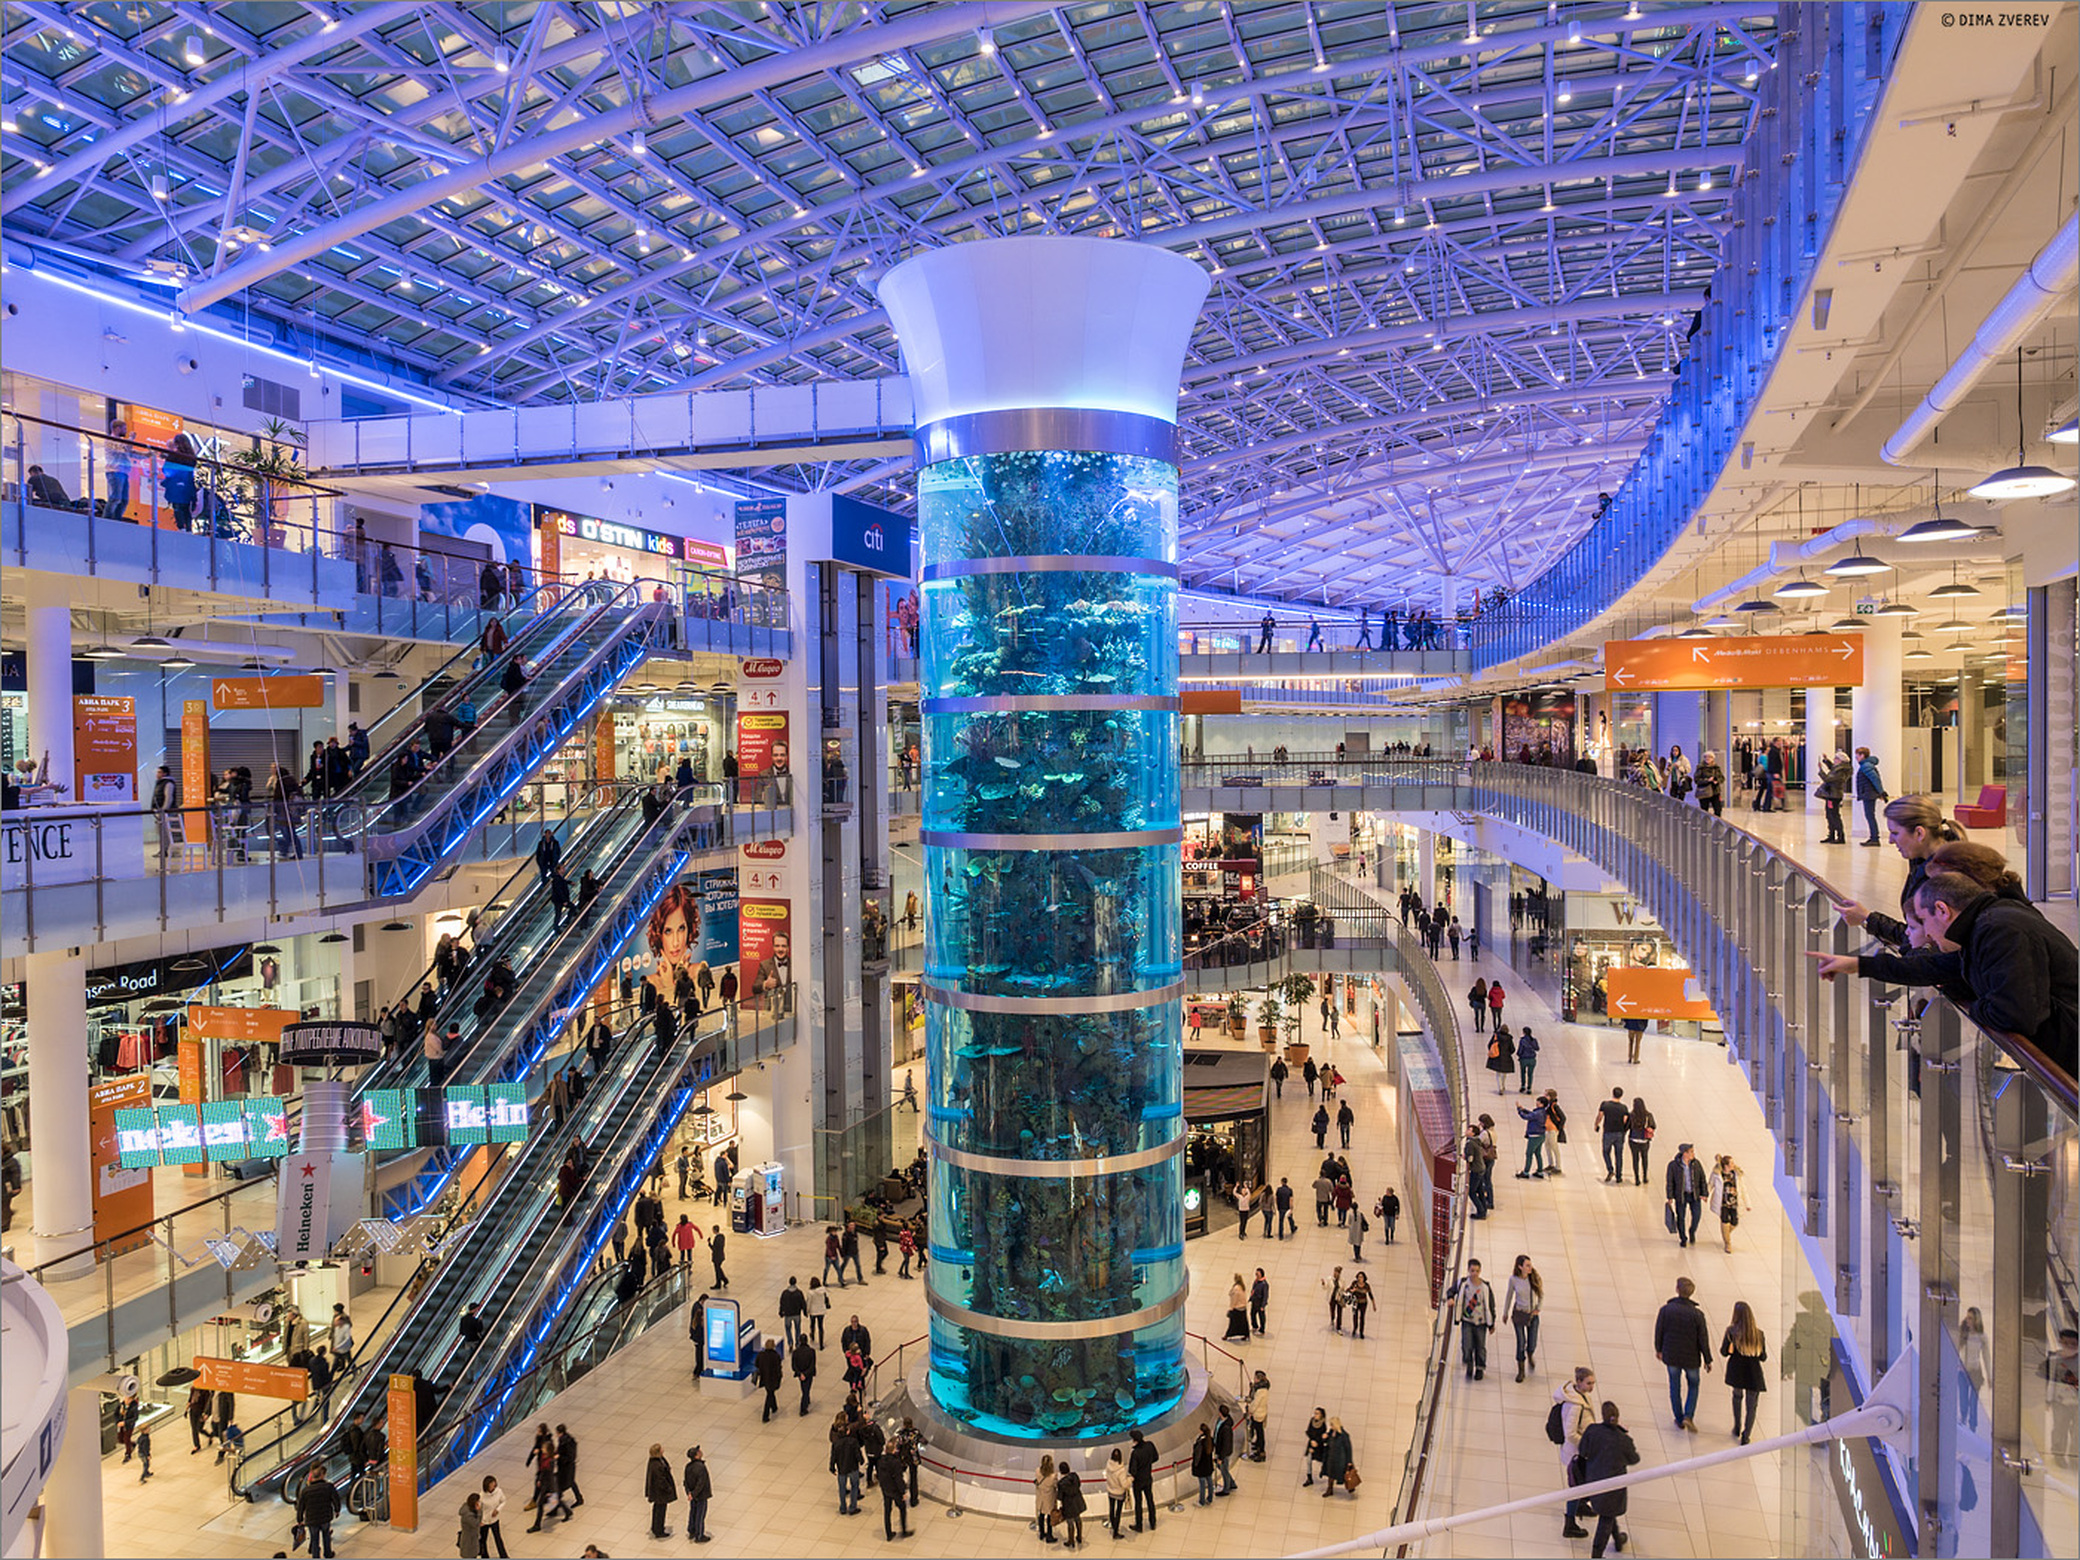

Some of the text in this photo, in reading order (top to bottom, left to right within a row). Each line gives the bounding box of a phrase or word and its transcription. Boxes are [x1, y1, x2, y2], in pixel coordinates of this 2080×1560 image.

[648, 533, 675, 555] kids
[864, 527, 884, 551] citi
[1766, 647, 1829, 655] DEBENHAMS
[751, 691, 758, 700] 4
[122, 700, 130, 712] 3
[186, 702, 192, 713] 3
[2, 824, 72, 863] ENCE
[1185, 862, 1219, 870] COFFEE
[751, 873, 759, 883] 4
[120, 968, 157, 991] Road
[137, 1080, 145, 1093] 2
[296, 1182, 315, 1252] Heineken
[393, 1378, 399, 1388] 1
